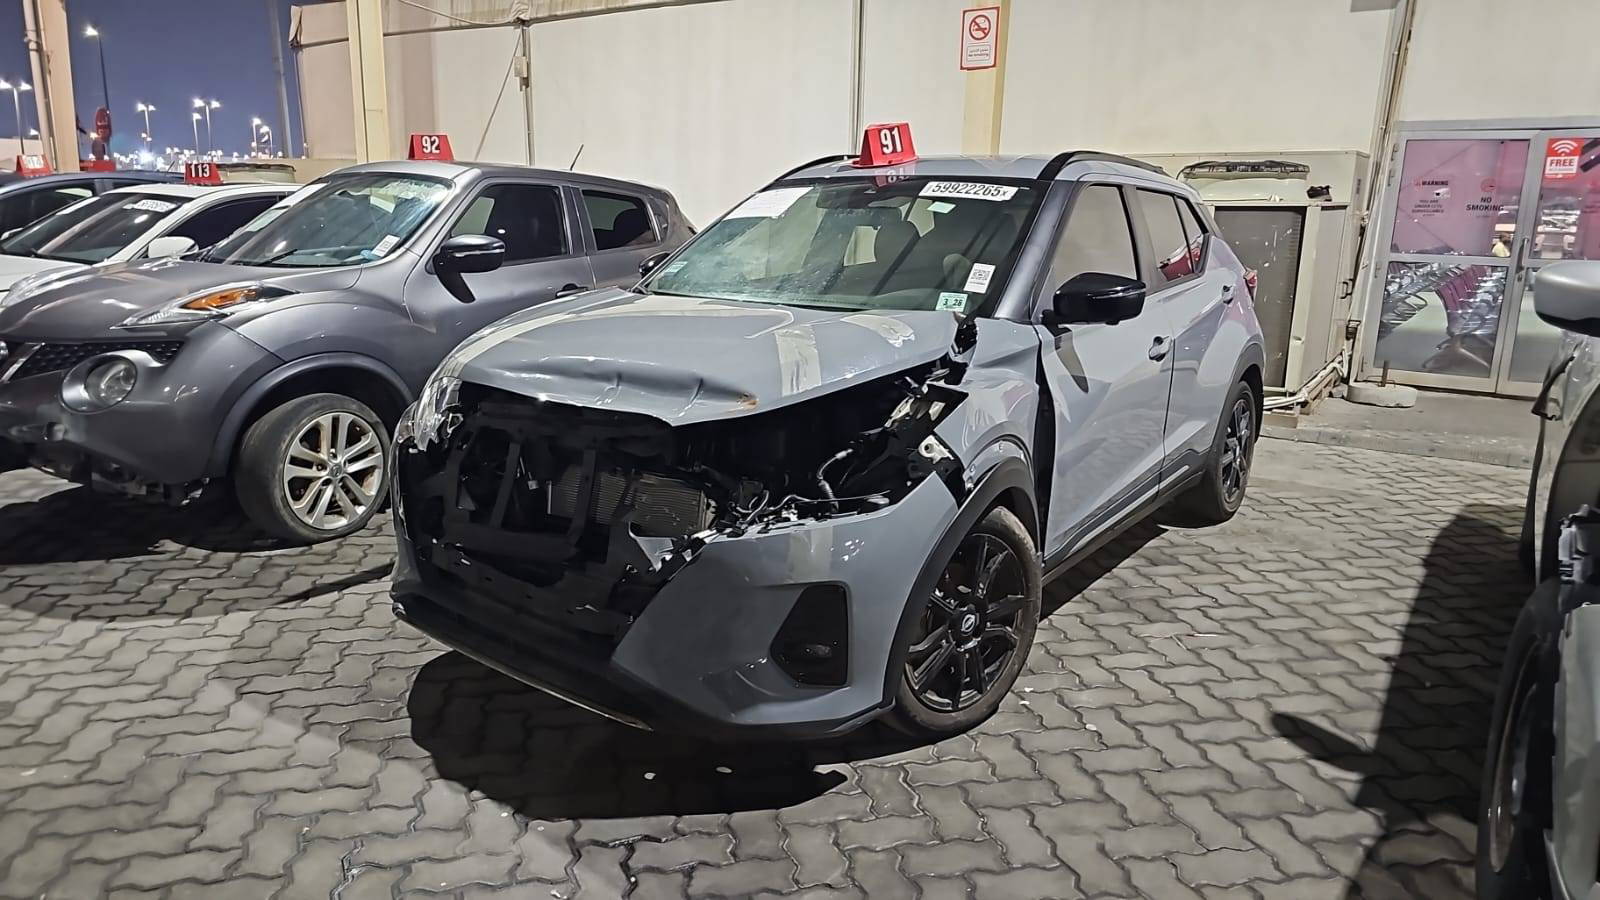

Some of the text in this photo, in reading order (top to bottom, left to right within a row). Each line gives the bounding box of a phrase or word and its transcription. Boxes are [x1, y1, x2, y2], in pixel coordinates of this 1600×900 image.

[422, 135, 440, 154] 92
[880, 126, 902, 154] 91
[190, 163, 210, 178] 113
[1550, 159, 1575, 167] FREE
[943, 298, 949, 306] 3
